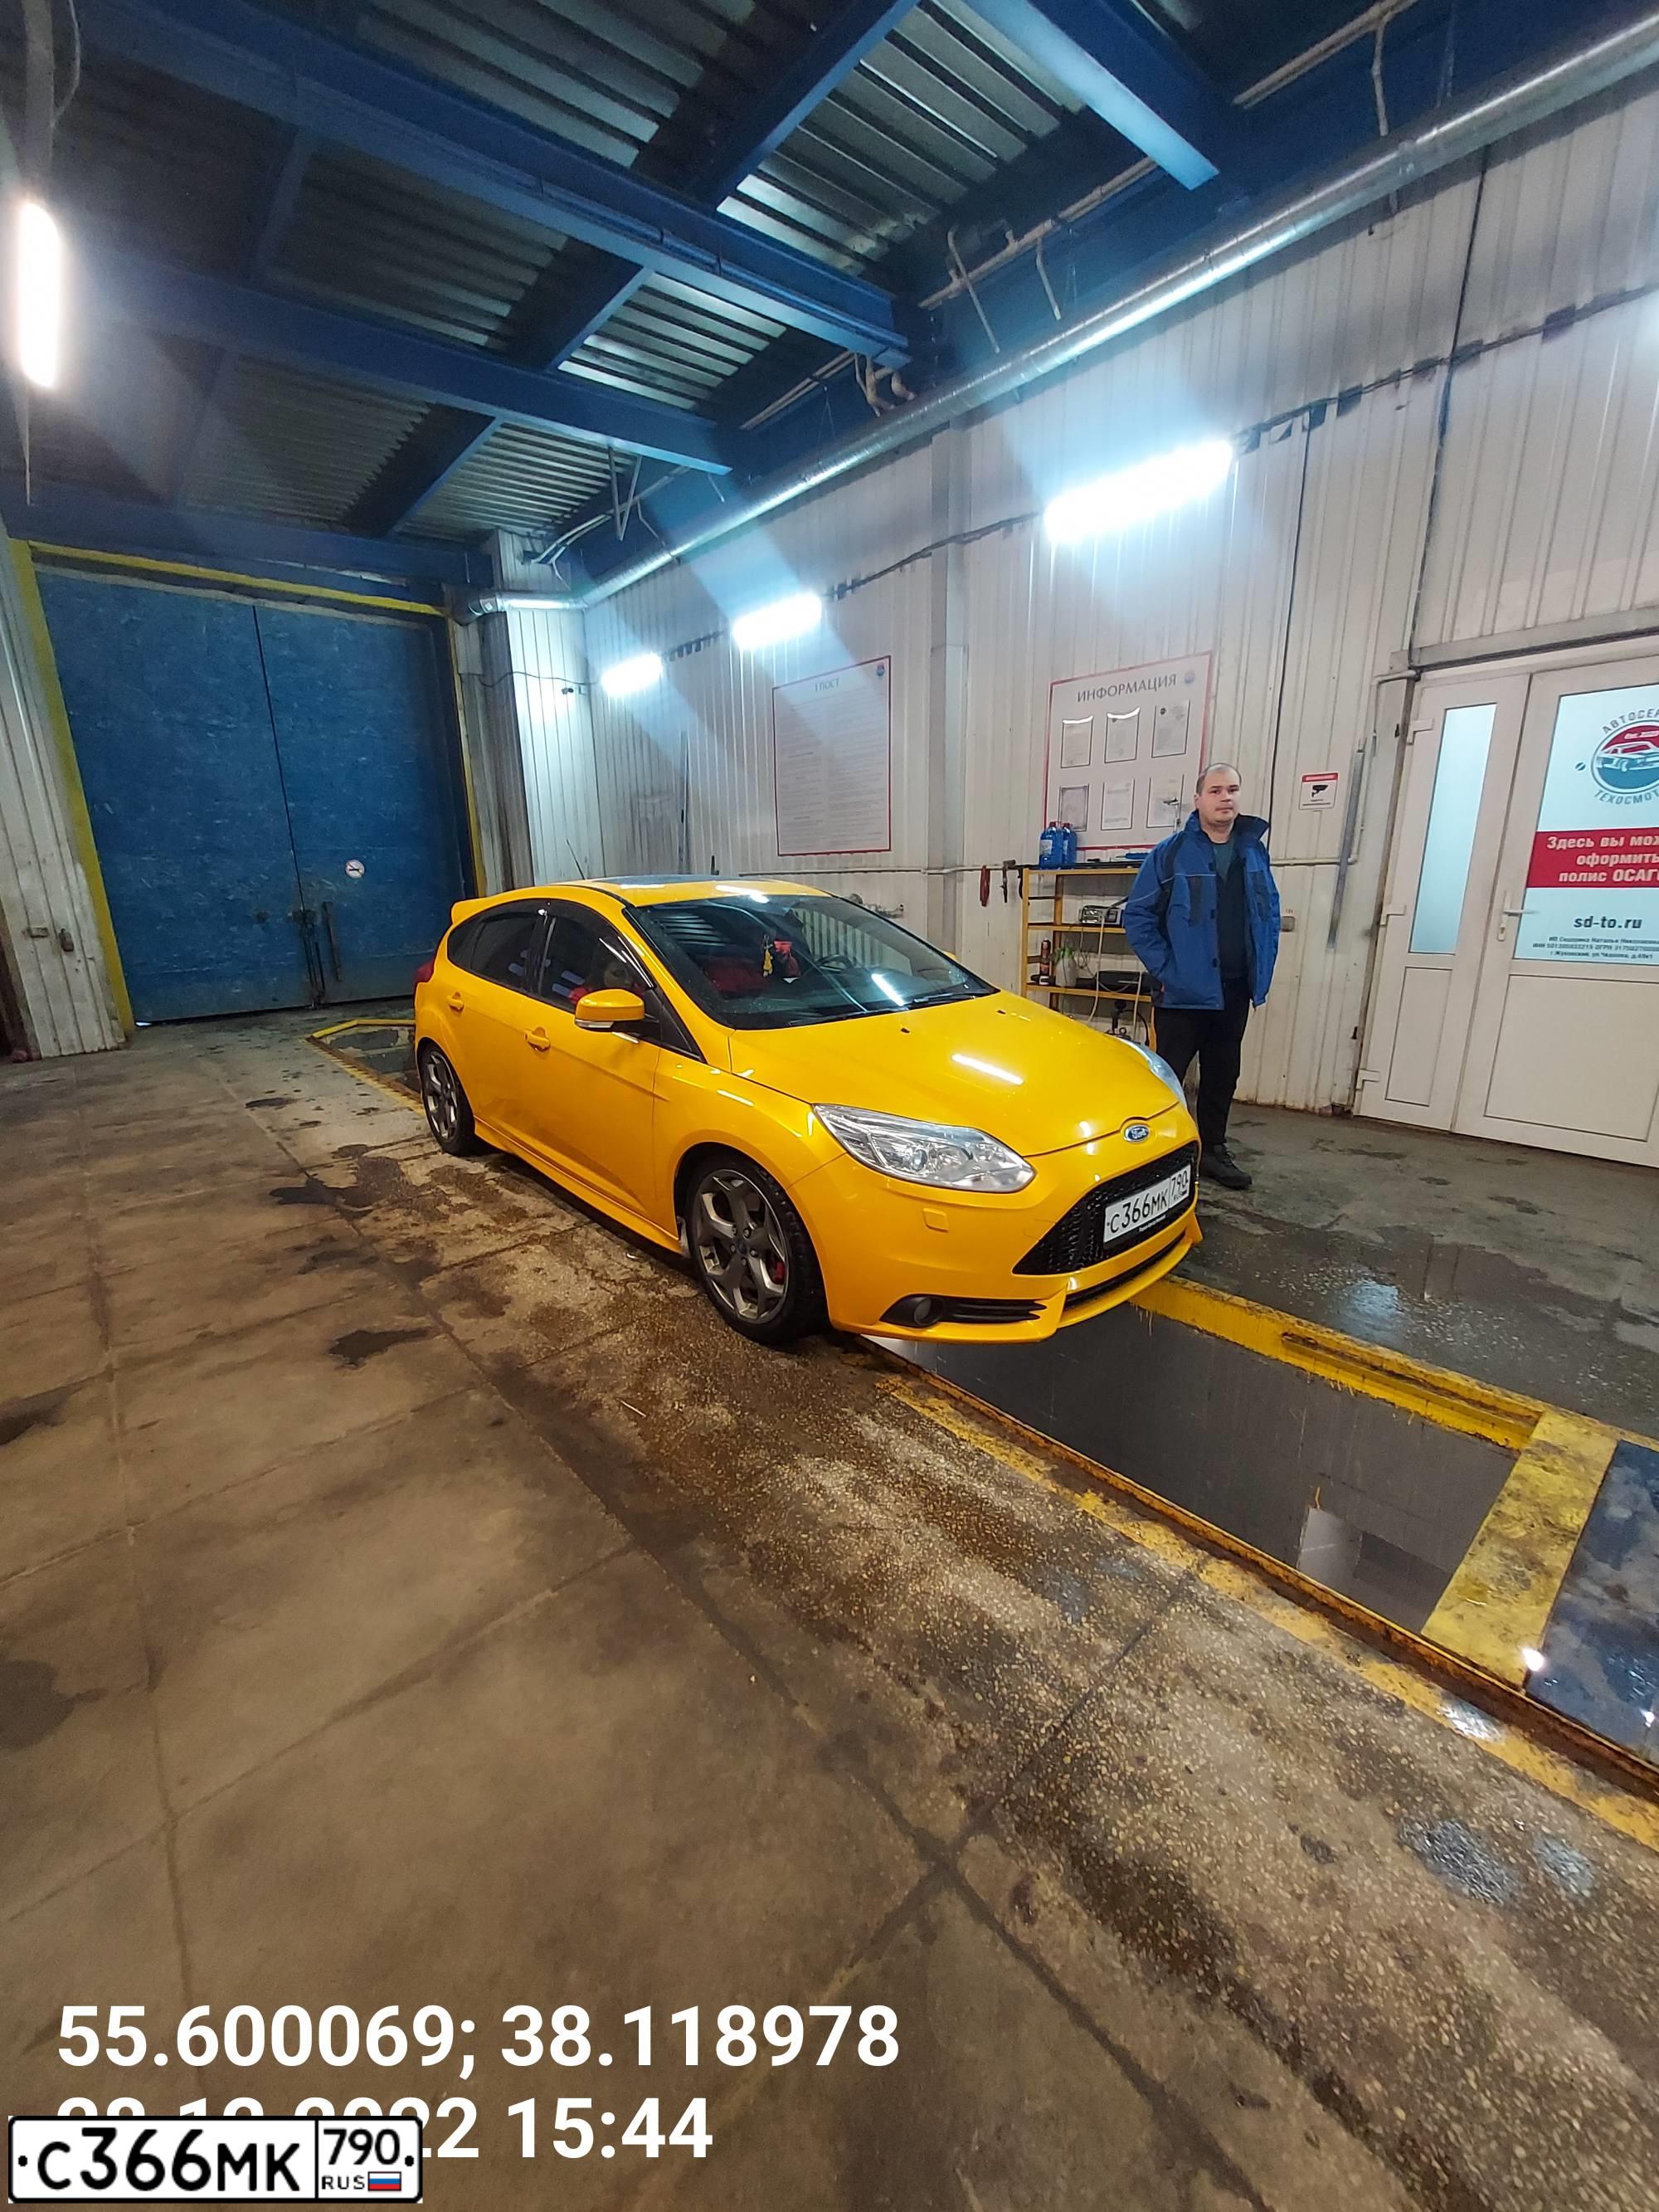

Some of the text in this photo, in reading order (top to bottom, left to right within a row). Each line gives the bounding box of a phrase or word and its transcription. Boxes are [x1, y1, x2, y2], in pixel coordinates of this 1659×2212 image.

[1077, 674, 1176, 702] ИНФОРМАЦИЯ
[1547, 836, 1594, 850] Здесь
[1600, 836, 1625, 847] вы
[1559, 872, 1607, 882] полис
[1574, 915, 1642, 928] sd-to.ru
